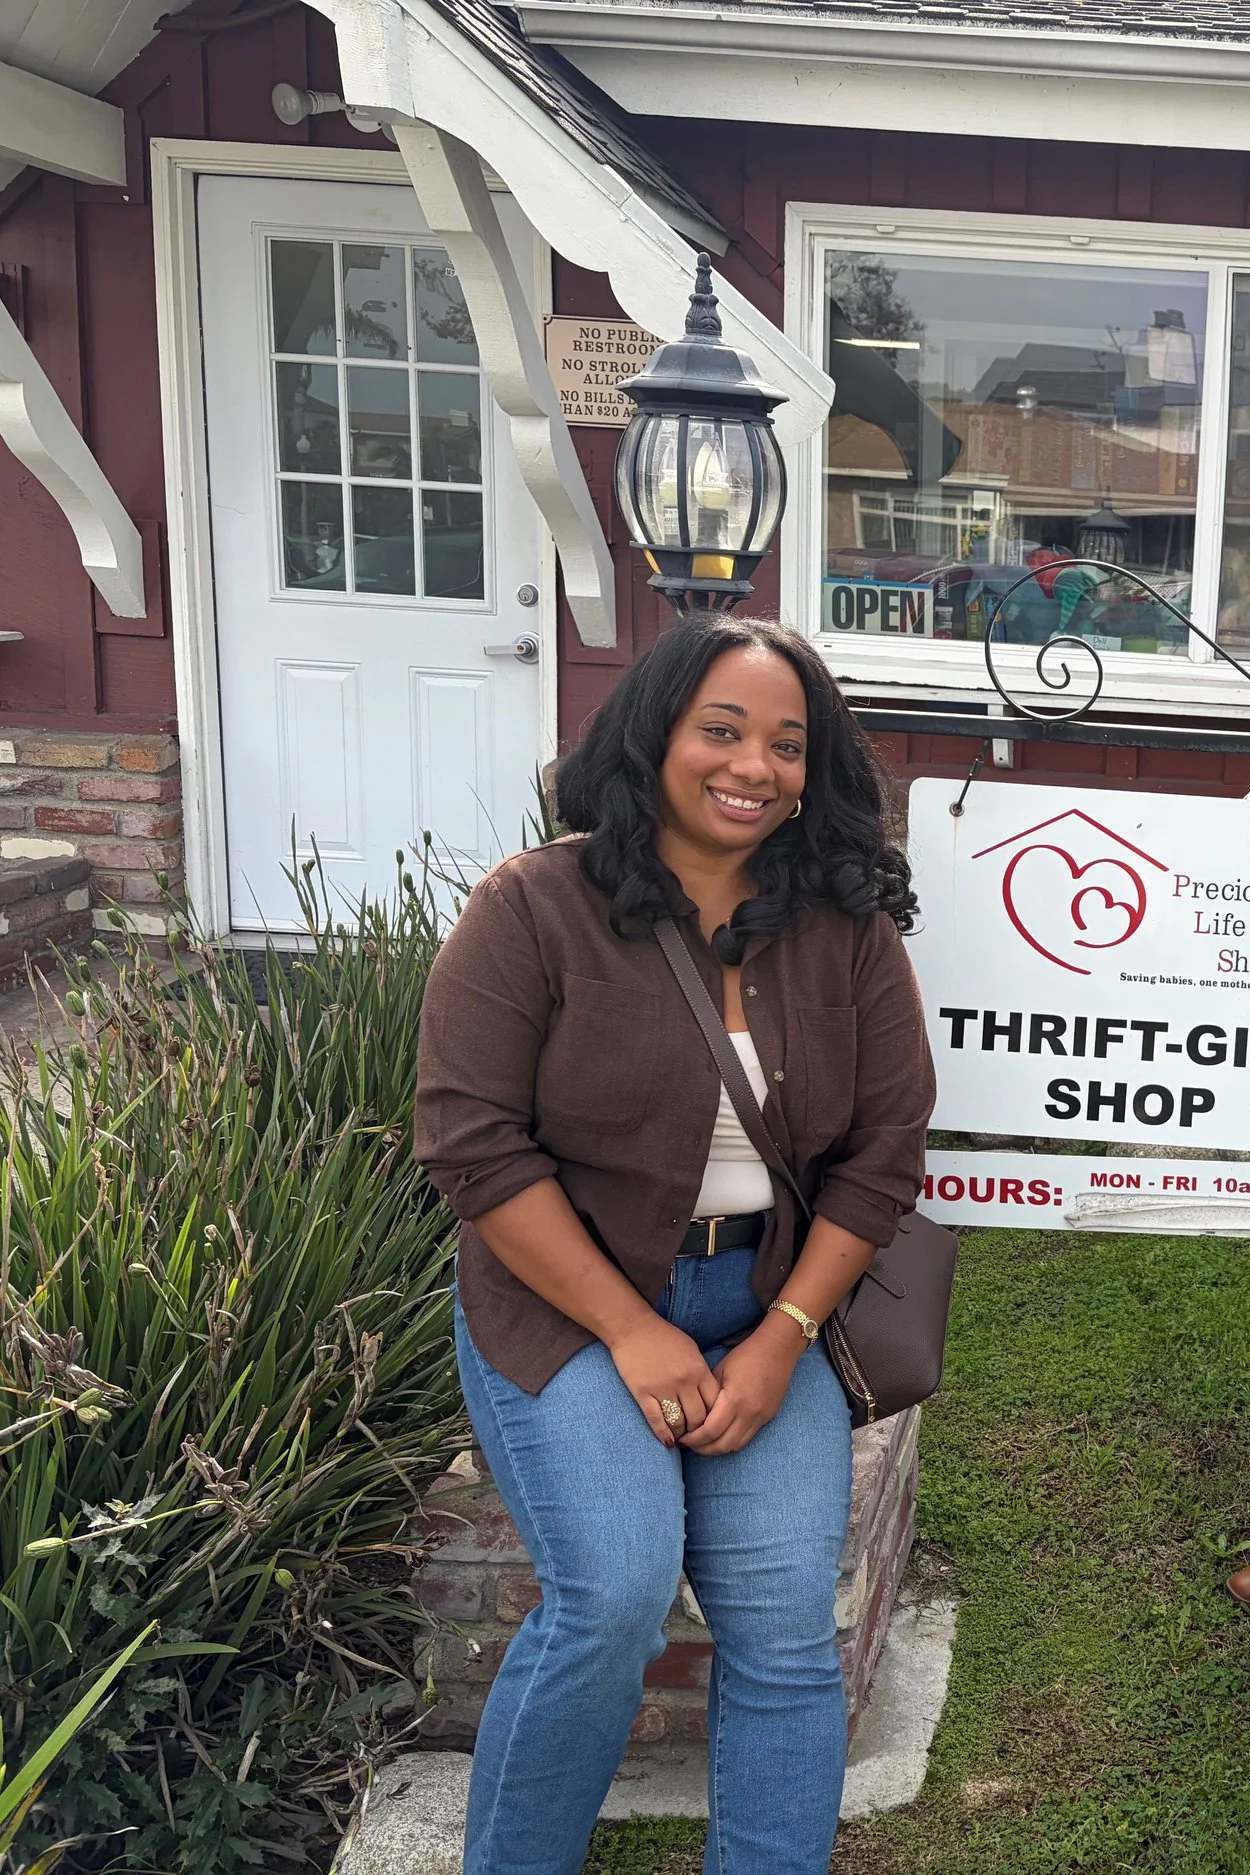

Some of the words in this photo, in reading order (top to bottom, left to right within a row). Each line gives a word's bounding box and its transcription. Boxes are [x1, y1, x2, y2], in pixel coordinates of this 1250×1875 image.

[580, 328, 601, 340] NO
[562, 359, 583, 371] NO
[589, 361, 646, 374] STROL
[583, 374, 629, 386] ALLO
[560, 390, 579, 402] NO
[584, 391, 625, 405] BILLS
[560, 403, 594, 416] HAN
[597, 405, 619, 417] $20
[832, 586, 925, 634] OPEN
[1193, 911, 1246, 937] Life
[1119, 972, 1157, 985] Saving
[1159, 974, 1197, 987] babies,
[1199, 979, 1218, 987] one
[1044, 1077, 1216, 1128] SHOP
[1090, 1172, 1141, 1189] MON
[1162, 1175, 1197, 1191] FRI
